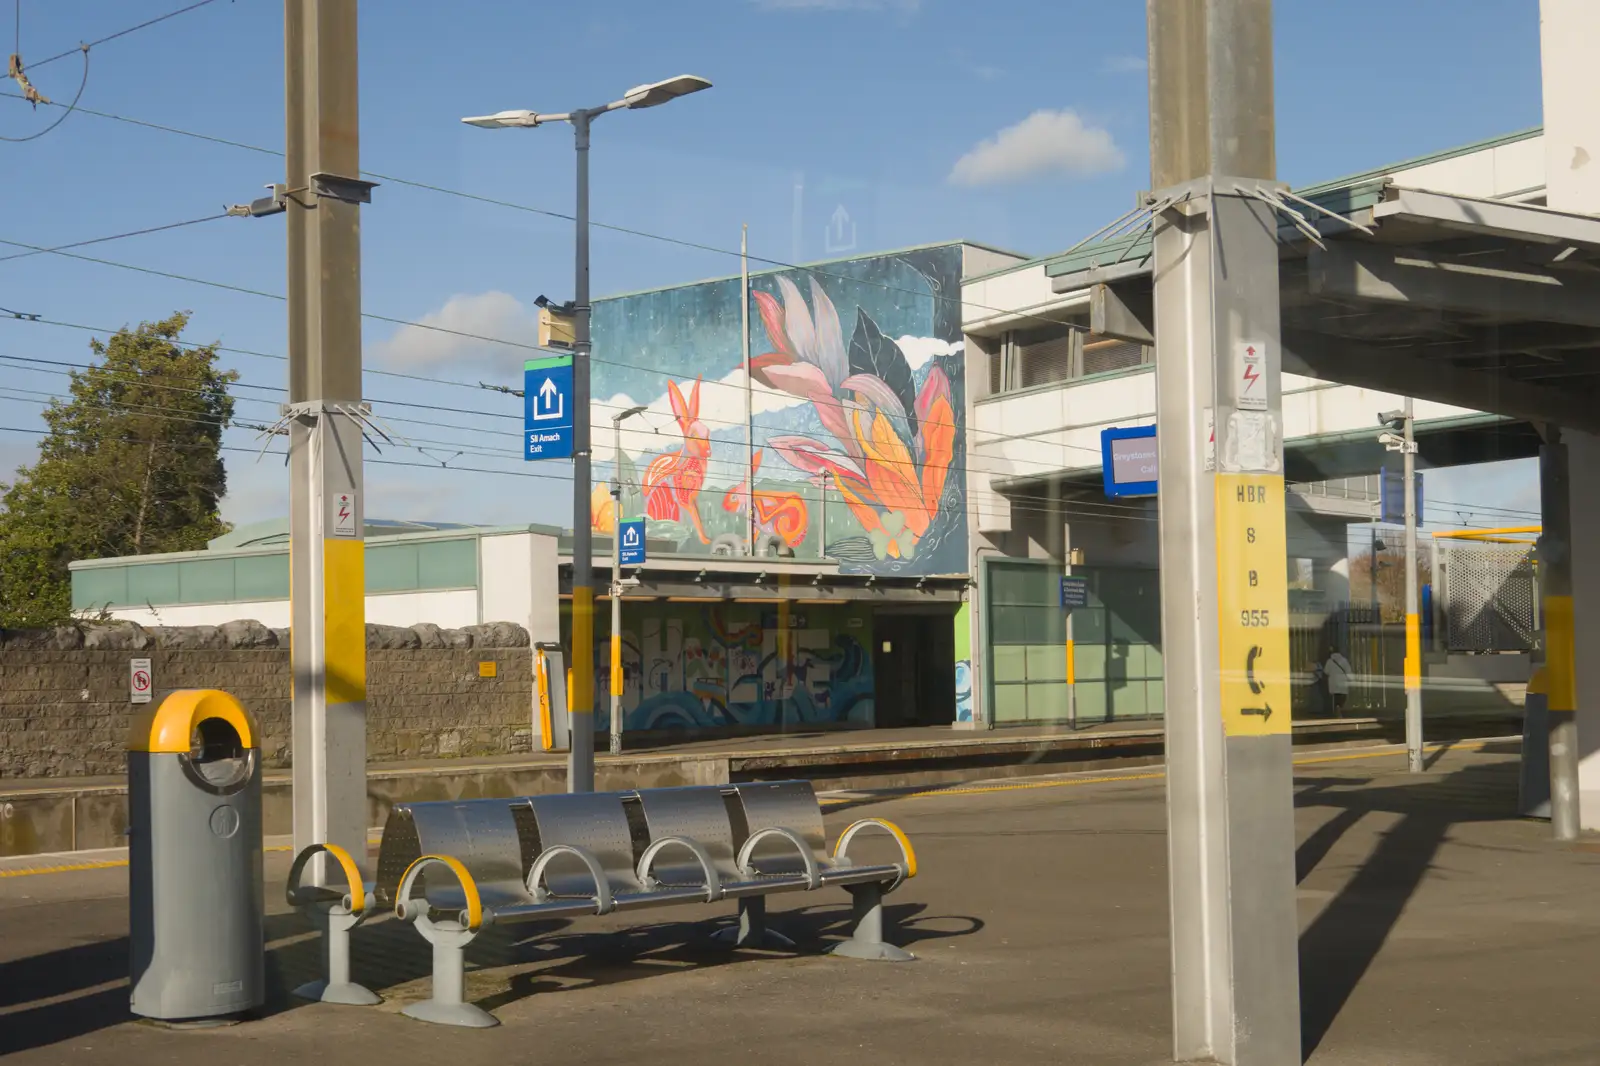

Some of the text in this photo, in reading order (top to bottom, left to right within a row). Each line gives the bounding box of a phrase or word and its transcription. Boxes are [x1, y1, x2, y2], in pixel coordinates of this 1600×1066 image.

[539, 432, 560, 442] Amach
[530, 444, 542, 453] Exit
[1237, 485, 1266, 503] HBR
[1249, 570, 1258, 586] B
[1241, 609, 1270, 627] 955
